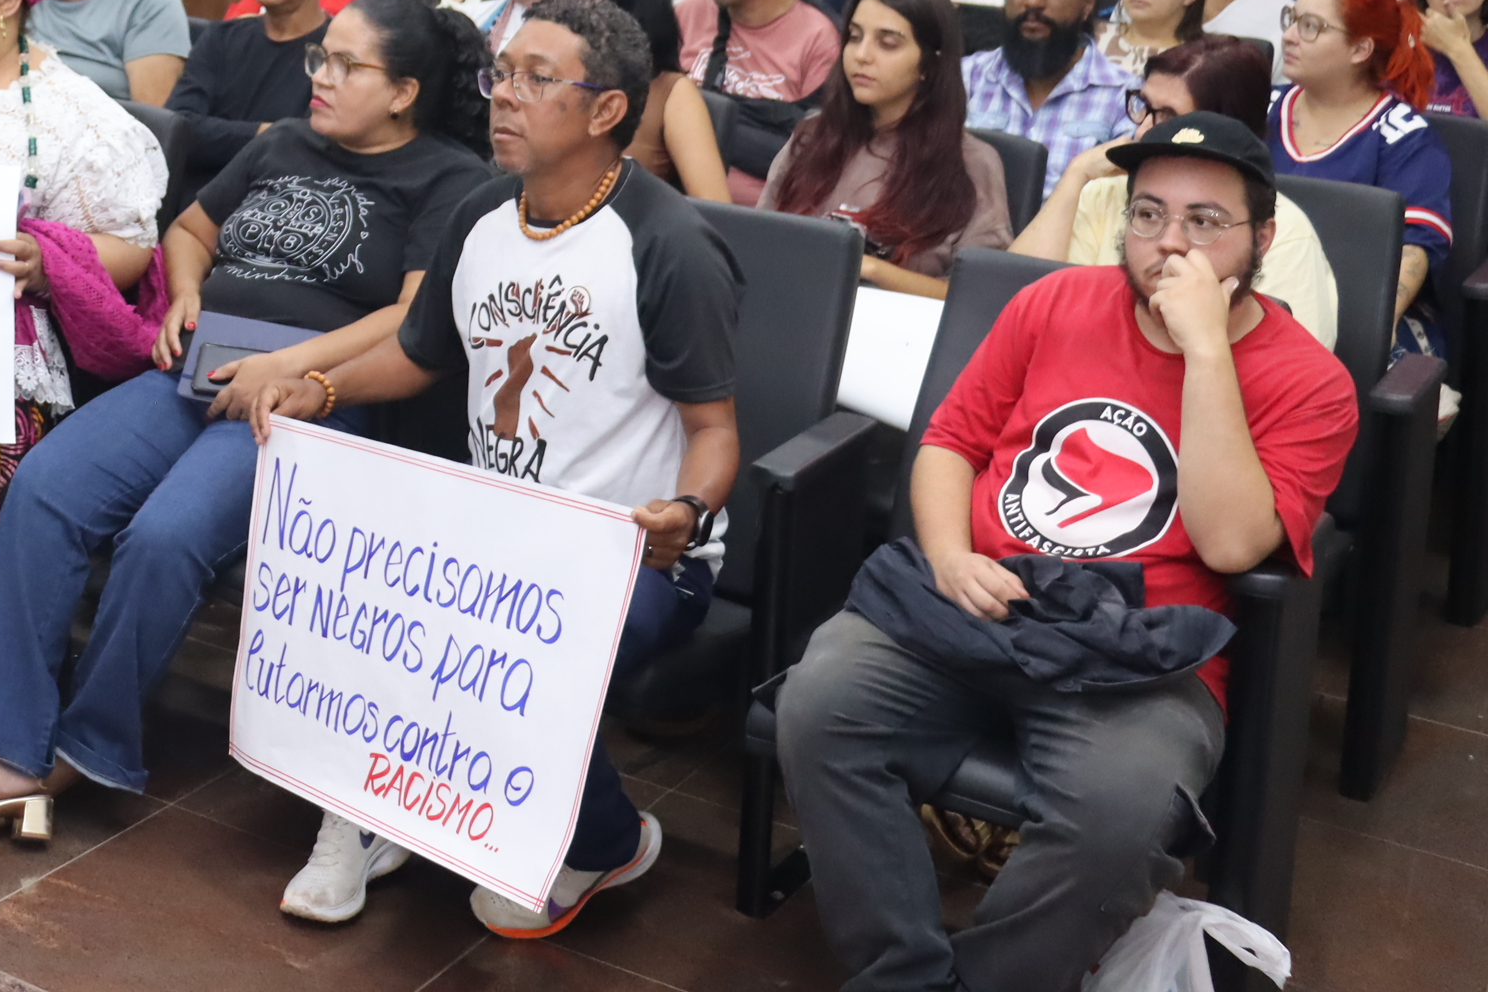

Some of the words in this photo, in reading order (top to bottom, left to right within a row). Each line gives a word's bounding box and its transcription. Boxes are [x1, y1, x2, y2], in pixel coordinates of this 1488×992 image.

[470, 415, 548, 484] NEGRA
[1100, 405, 1148, 437] AÇÃO
[262, 456, 336, 563] Não
[340, 526, 564, 644] precisamos
[245, 629, 380, 743] lutarmos
[382, 711, 492, 794] contra
[253, 561, 307, 626] ser
[431, 633, 534, 716] para
